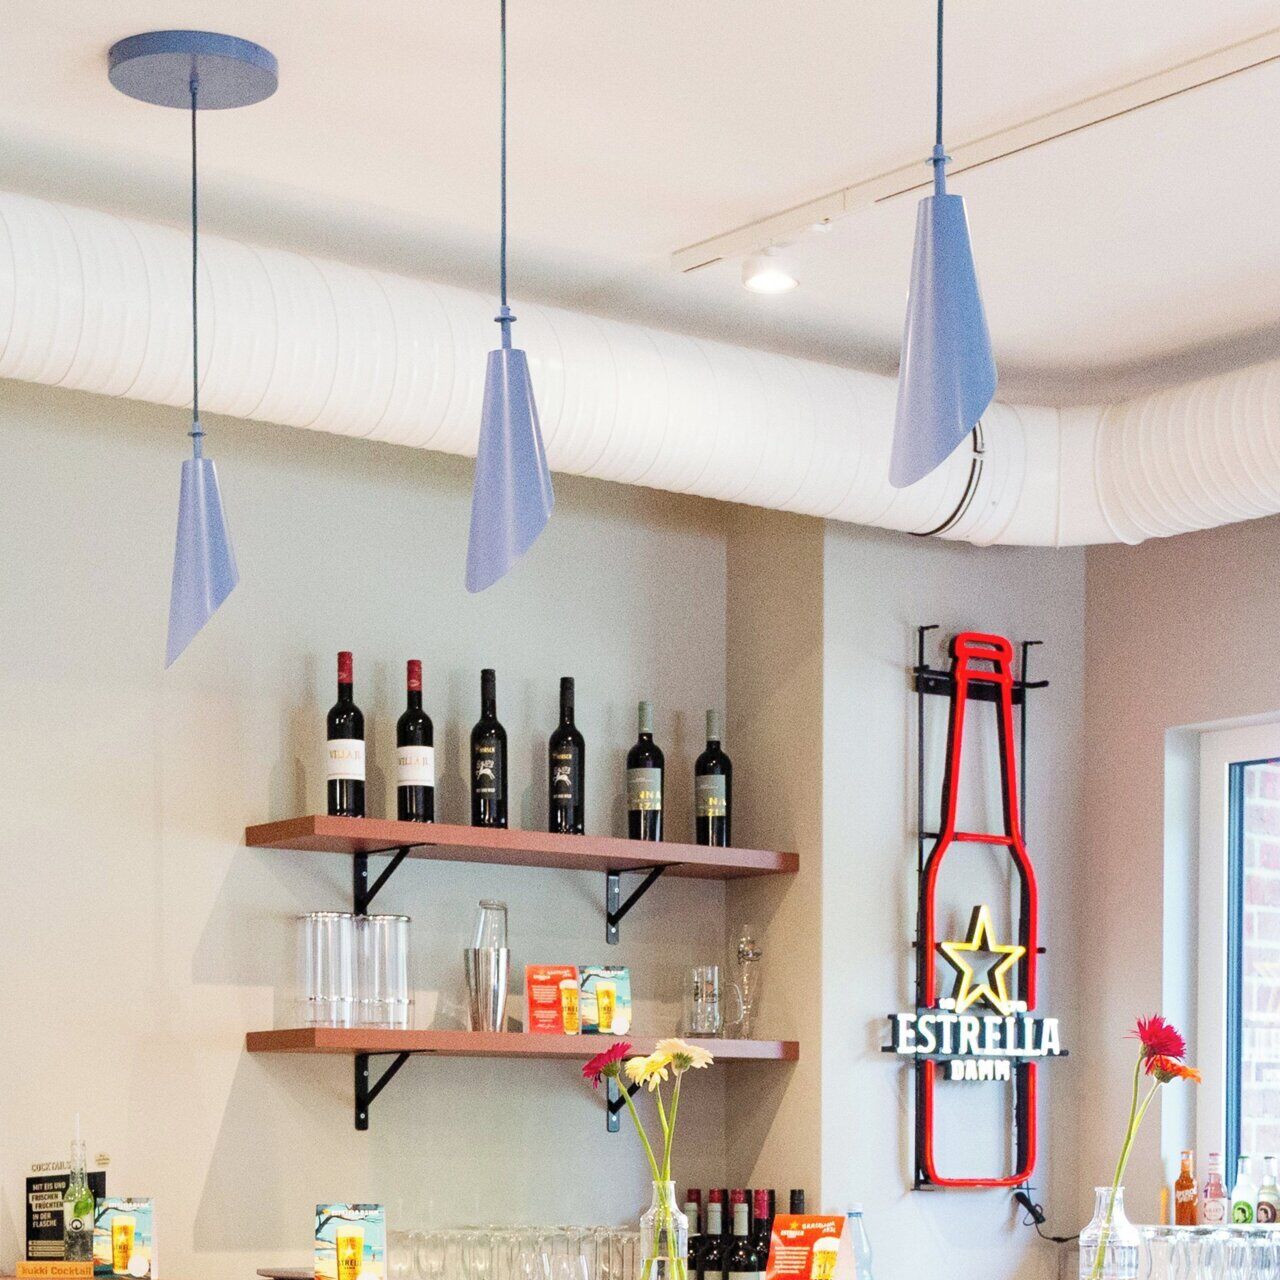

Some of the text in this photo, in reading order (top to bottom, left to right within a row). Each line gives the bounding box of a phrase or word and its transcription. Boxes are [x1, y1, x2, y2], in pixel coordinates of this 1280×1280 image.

[896, 1013, 1061, 1055] ESTRELLA
[950, 1059, 1011, 1081] DAMM
[32, 1183, 43, 1191] MIT
[32, 1193, 59, 1201] FRISCHEN
[32, 1219, 57, 1228] FLASCHE
